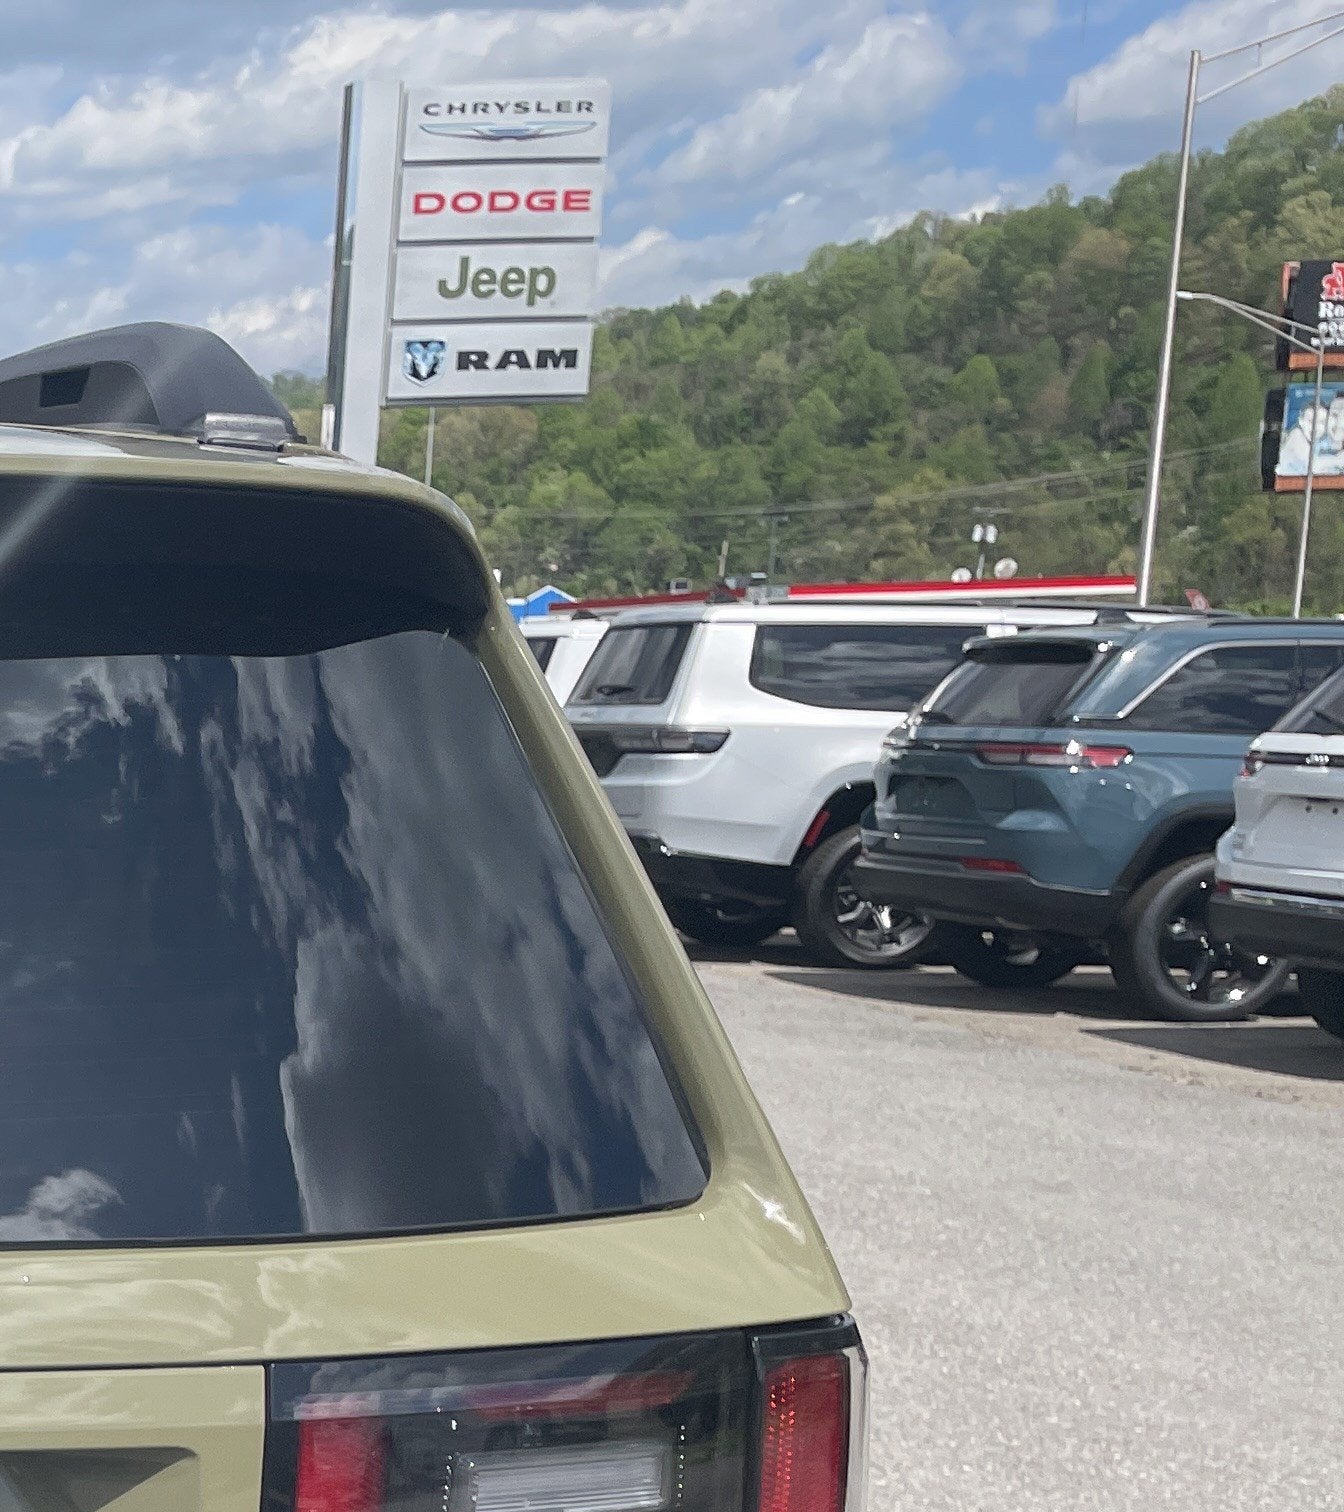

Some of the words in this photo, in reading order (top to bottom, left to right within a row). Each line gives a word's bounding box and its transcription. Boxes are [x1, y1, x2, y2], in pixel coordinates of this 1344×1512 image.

[422, 99, 596, 116] CHRYSLER
[412, 188, 593, 216] DODGE
[436, 255, 558, 308] Jeep
[455, 348, 580, 372] RAM
